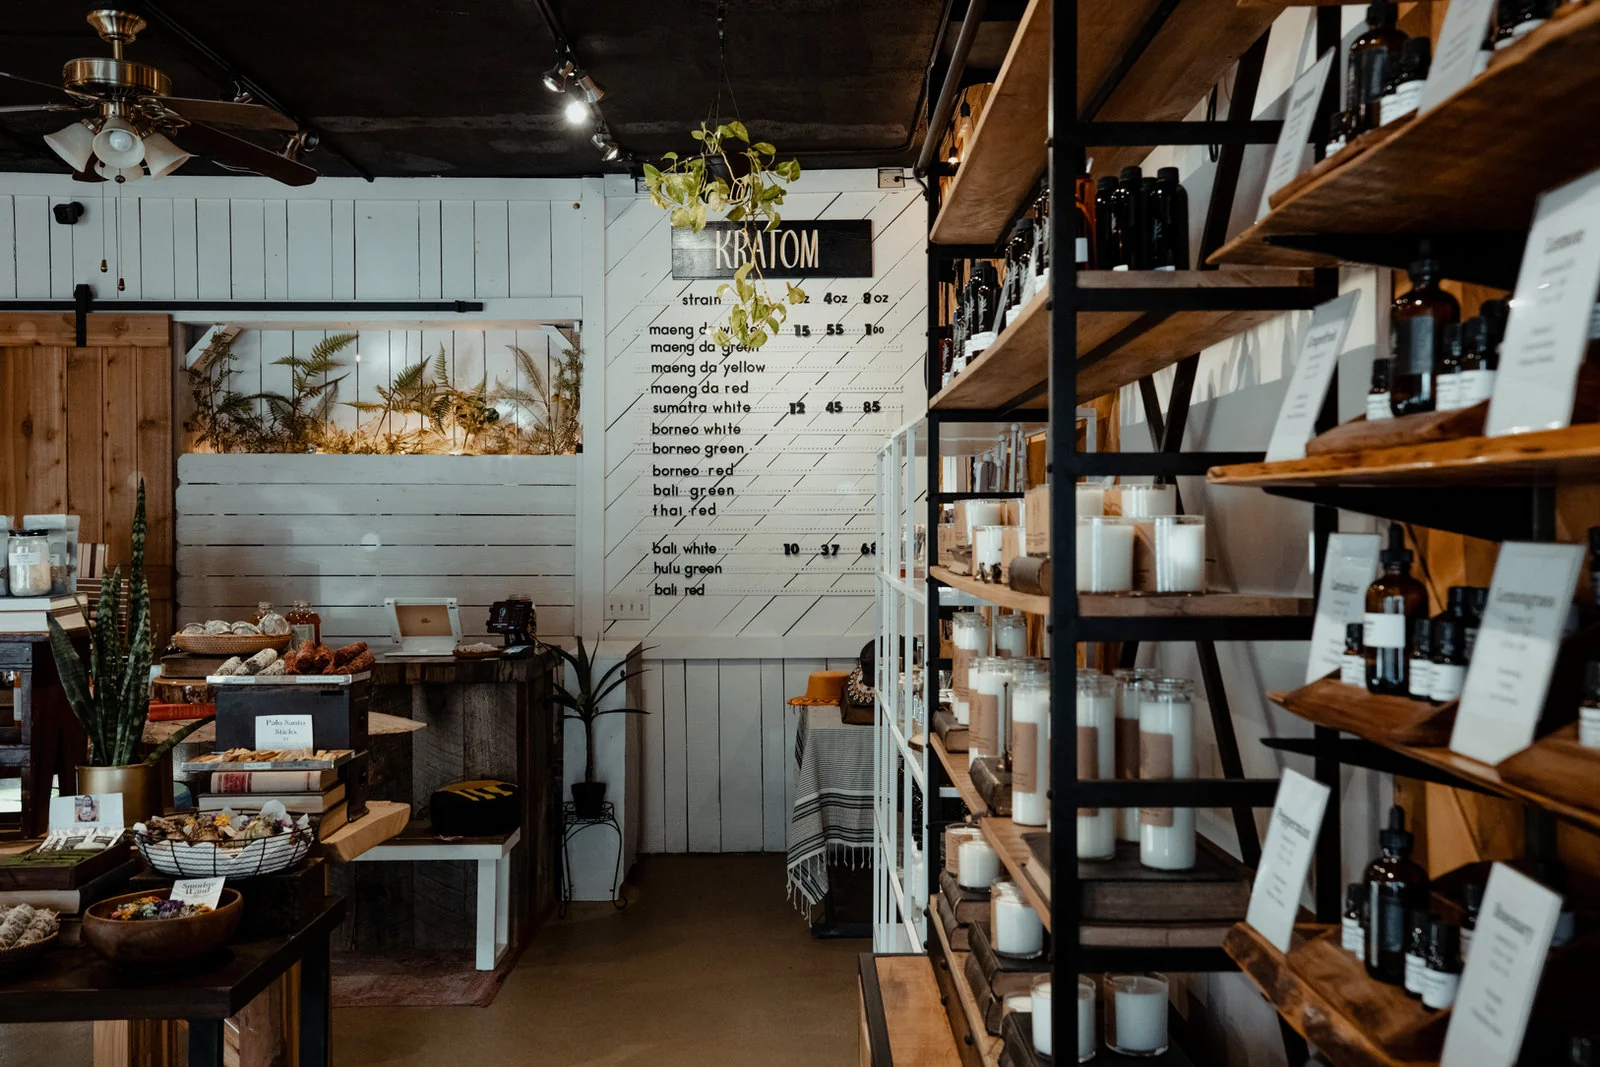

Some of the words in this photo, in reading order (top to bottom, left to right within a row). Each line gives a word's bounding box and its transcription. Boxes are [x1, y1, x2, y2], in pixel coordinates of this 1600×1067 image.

[716, 229, 819, 269] KRATOM
[682, 293, 721, 305] strain
[823, 292, 848, 304] 4oz
[649, 326, 694, 339] maeng
[794, 324, 811, 336] 15
[826, 324, 844, 335] 55
[650, 343, 695, 356] maeng
[699, 340, 716, 352] da
[651, 364, 696, 377] maeng
[700, 361, 717, 373] da
[723, 361, 766, 378] yellow
[651, 385, 698, 399] maeng
[701, 381, 719, 394] da
[725, 380, 749, 394] red
[653, 401, 707, 413] sumatra
[713, 400, 751, 413] white
[789, 402, 806, 415] 12
[825, 401, 843, 413] 45
[863, 401, 881, 413] 85
[652, 422, 699, 435] borneo
[703, 422, 741, 435] white
[652, 442, 701, 454] borneo
[704, 445, 744, 458] green
[652, 464, 699, 477] borneo
[708, 462, 734, 476] red
[653, 483, 679, 496] bali
[690, 487, 735, 500] green
[653, 504, 683, 516] thai
[690, 502, 717, 516] red
[652, 542, 677, 555] bali
[683, 542, 717, 555] white
[783, 543, 800, 556] 10
[820, 544, 840, 557] 37
[684, 565, 723, 578] green
[654, 583, 677, 596] bali
[684, 583, 705, 596] red
